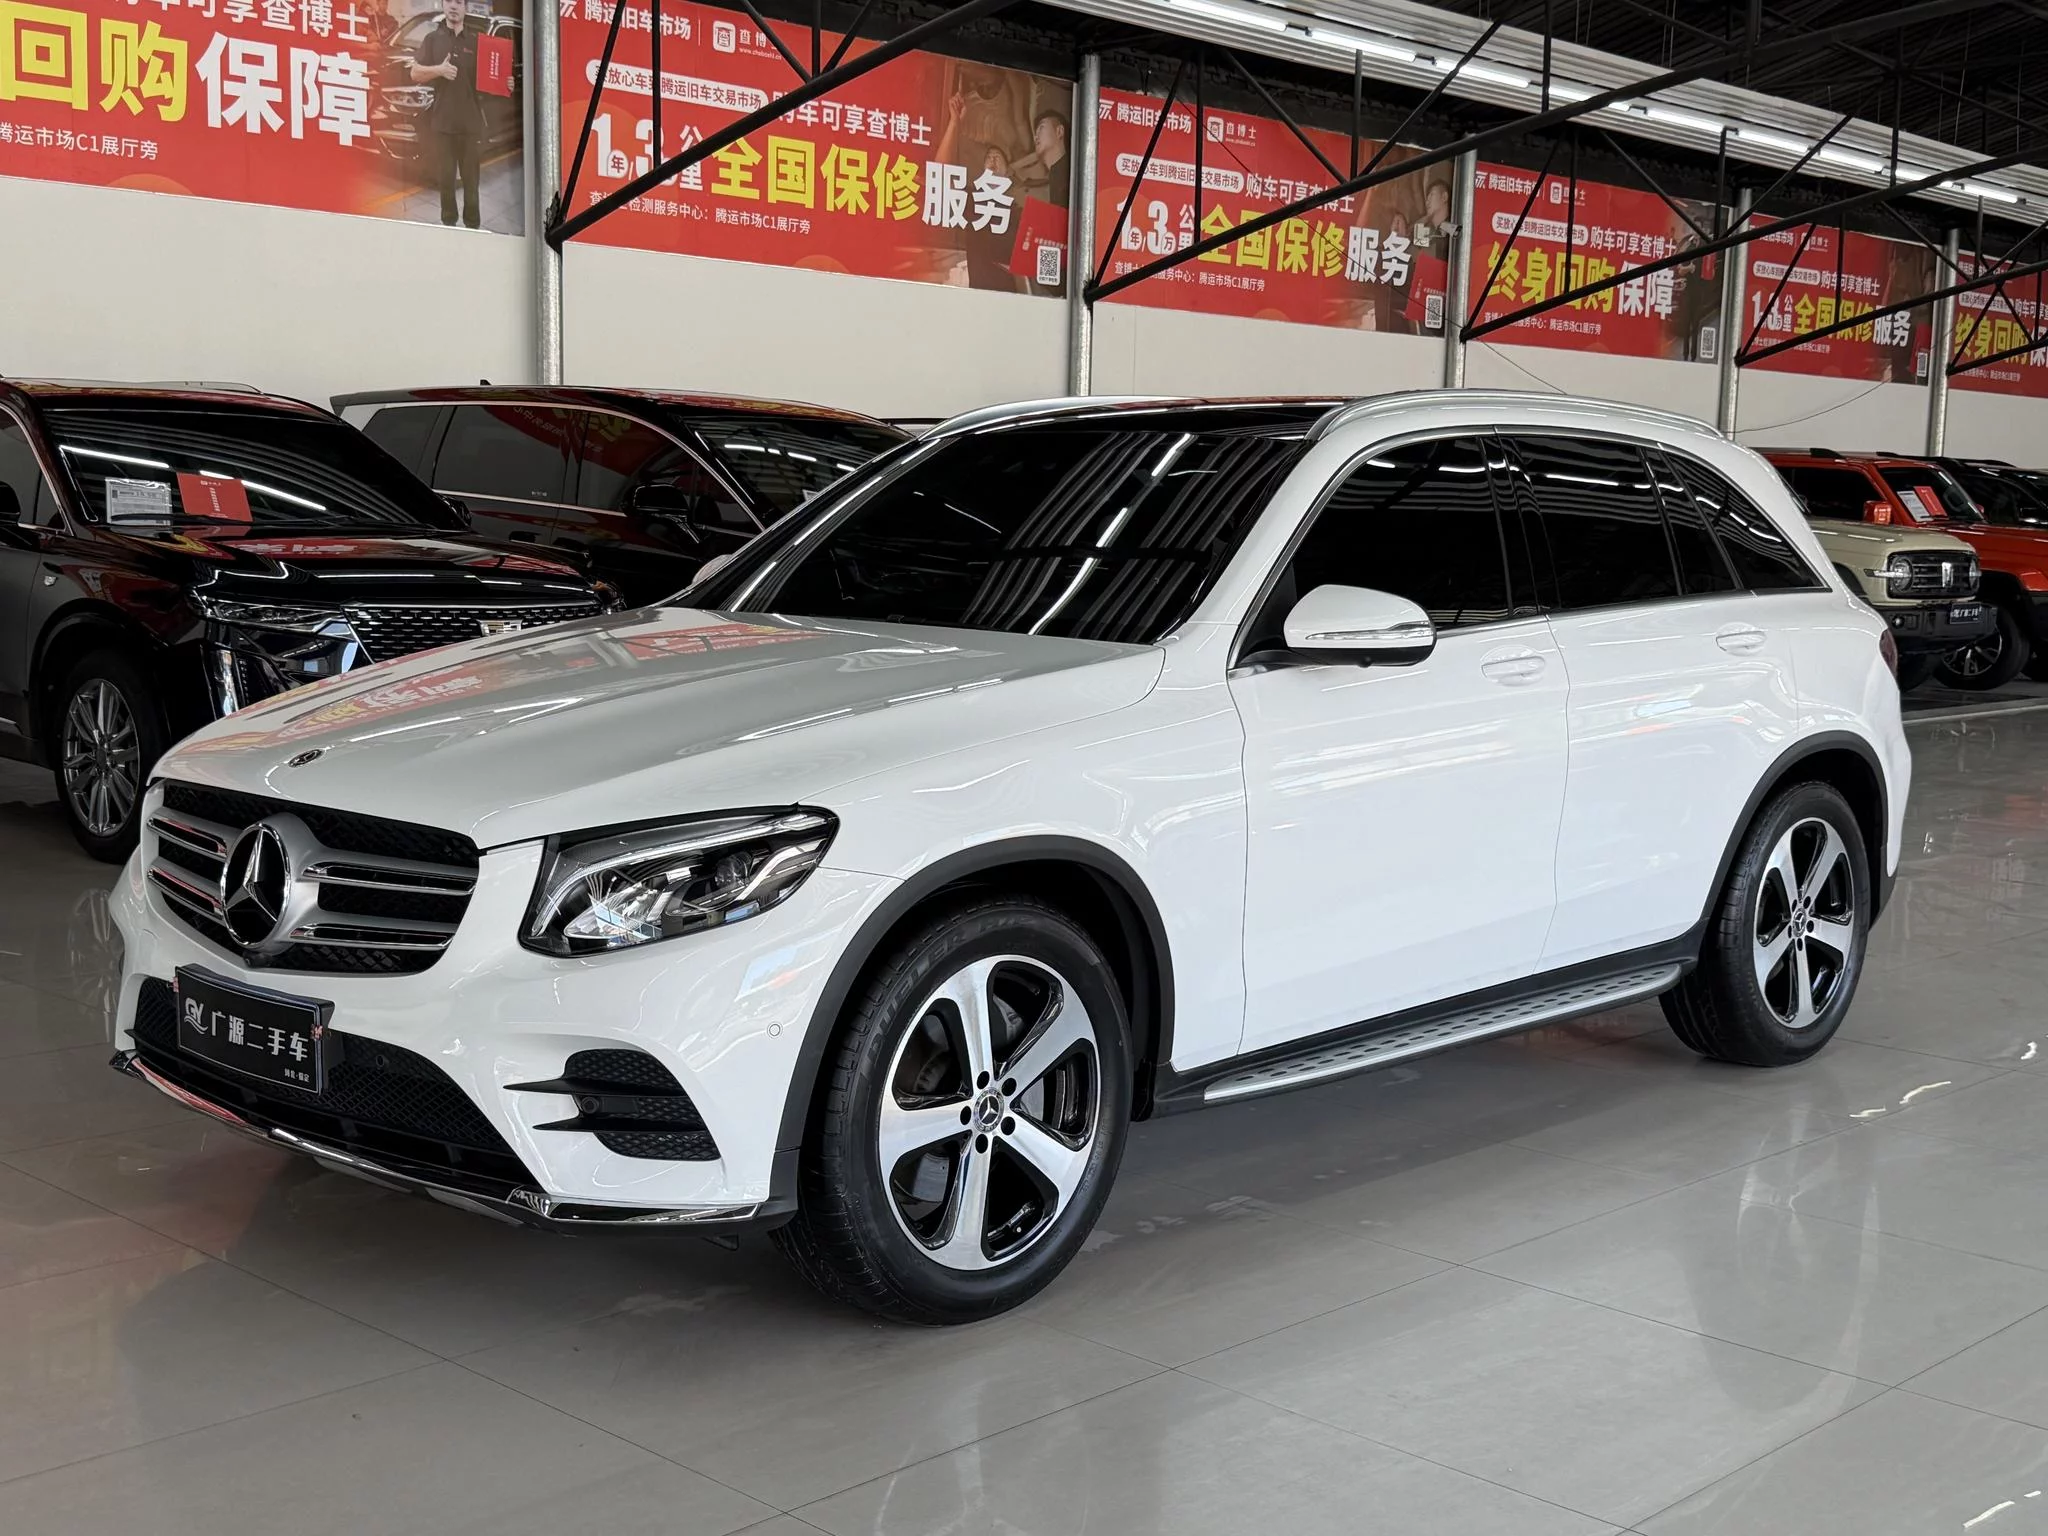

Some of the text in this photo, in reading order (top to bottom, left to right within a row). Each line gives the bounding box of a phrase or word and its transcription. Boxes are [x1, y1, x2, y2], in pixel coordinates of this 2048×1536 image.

[115, 0, 370, 43] 可享查博士
[739, 28, 778, 50] 查博
[0, 0, 371, 147] 回购保障
[589, 190, 812, 235] 查检测服务中心：腾运市场C1展厅旁
[1496, 216, 1585, 241] 买放到腾运旧车交市场
[1954, 312, 2048, 368] 终身回购保
[211, 1010, 309, 1062] 广源二手车
